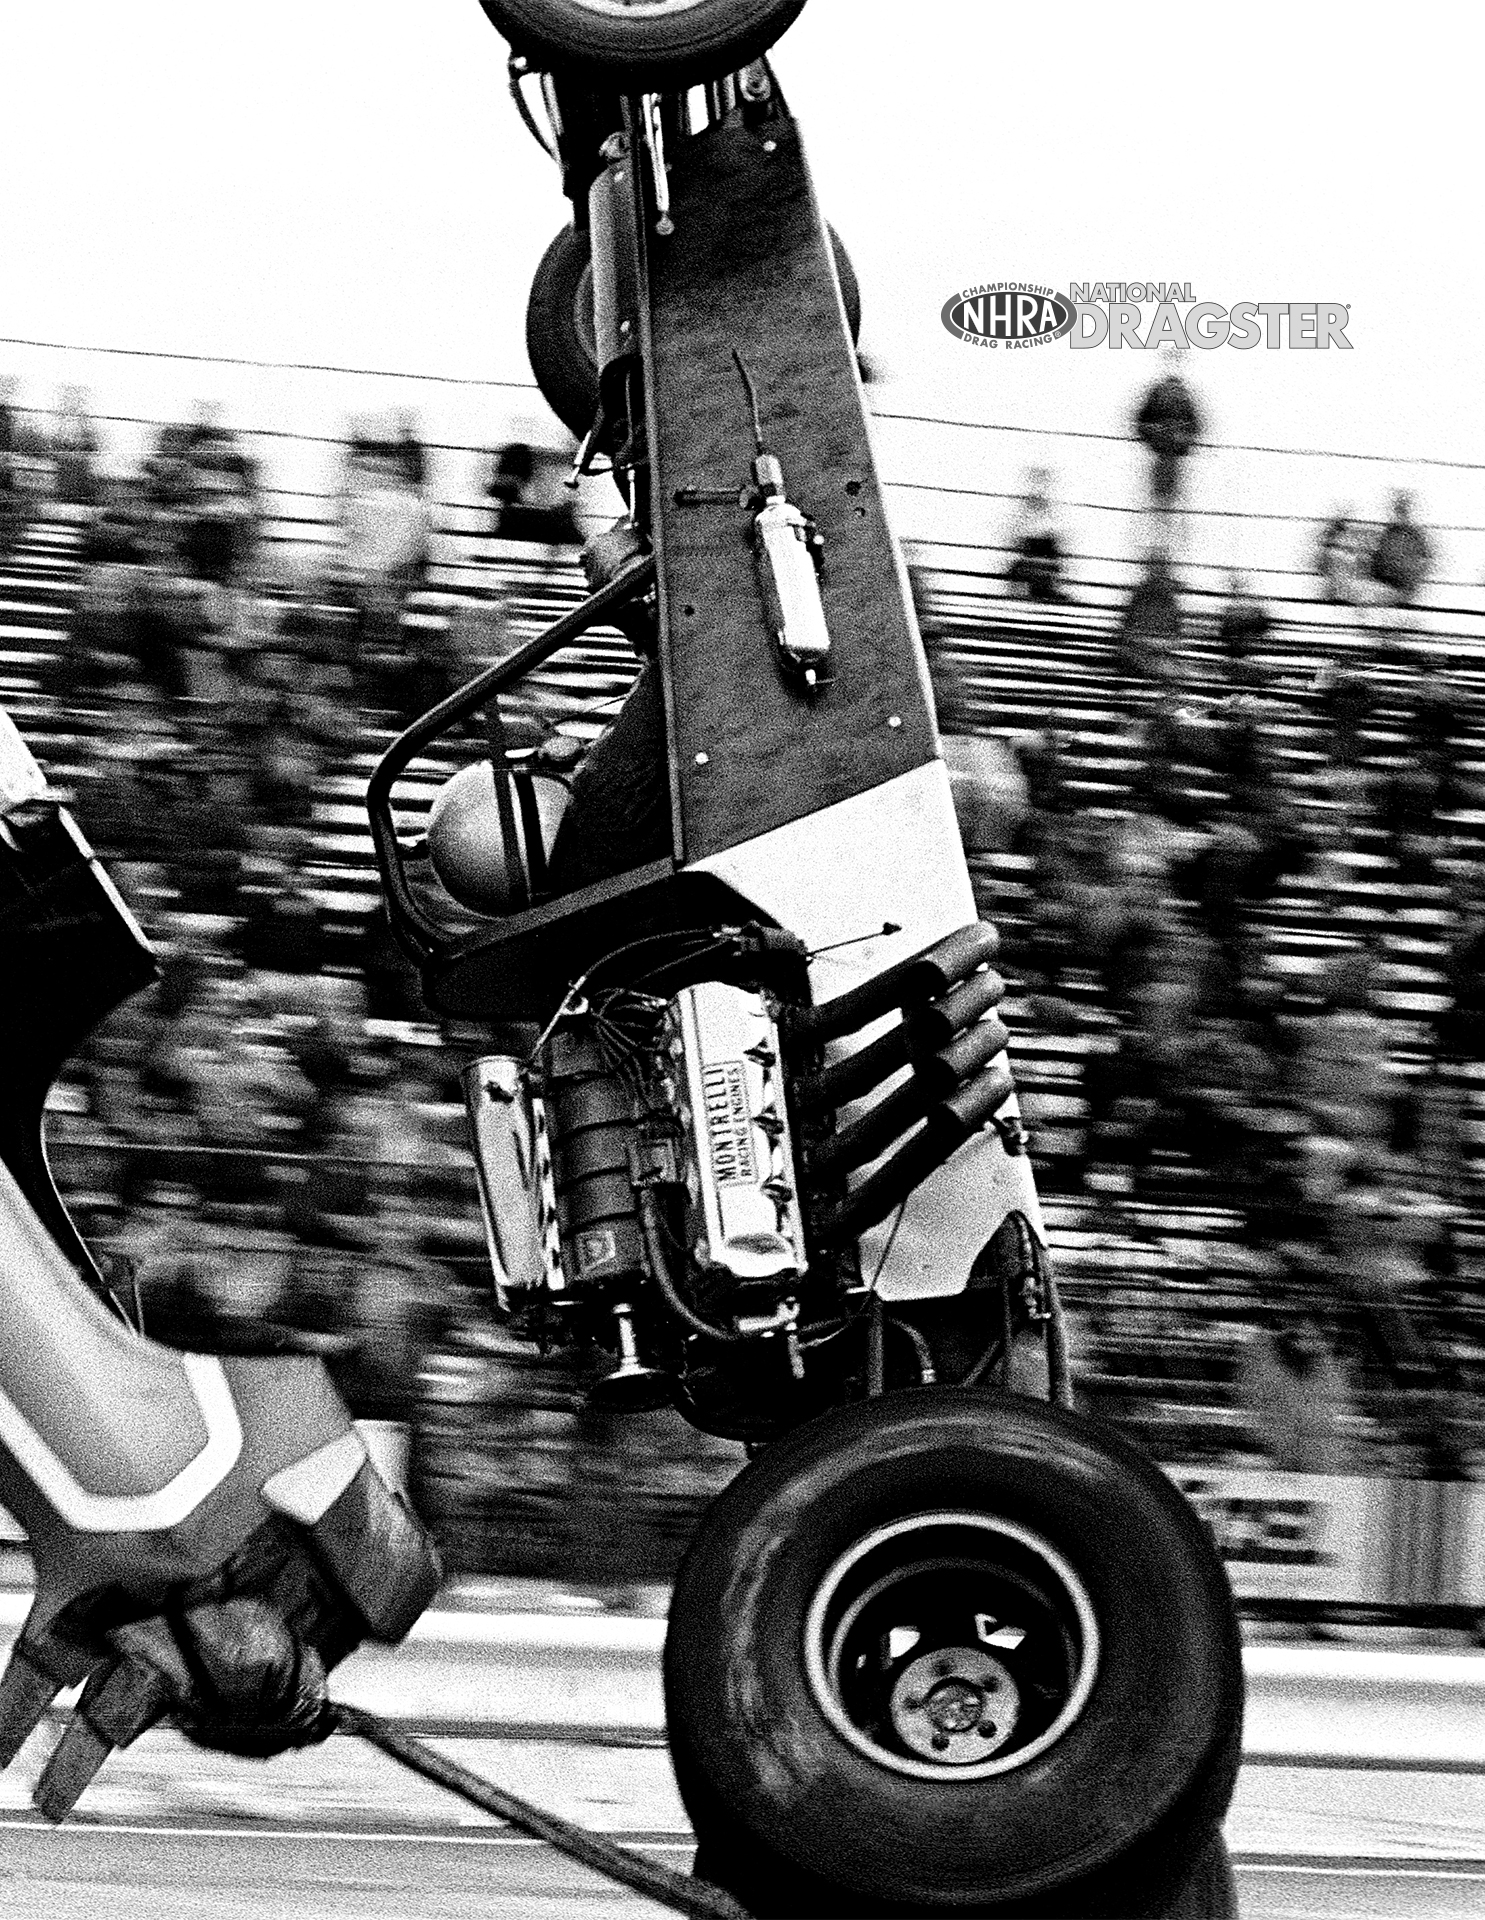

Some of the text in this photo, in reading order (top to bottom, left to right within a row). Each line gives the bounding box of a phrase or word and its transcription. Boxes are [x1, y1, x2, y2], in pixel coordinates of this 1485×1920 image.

[704, 1068, 736, 1180] MONTRELLI
[727, 1067, 752, 1177] RACING ENGINES
